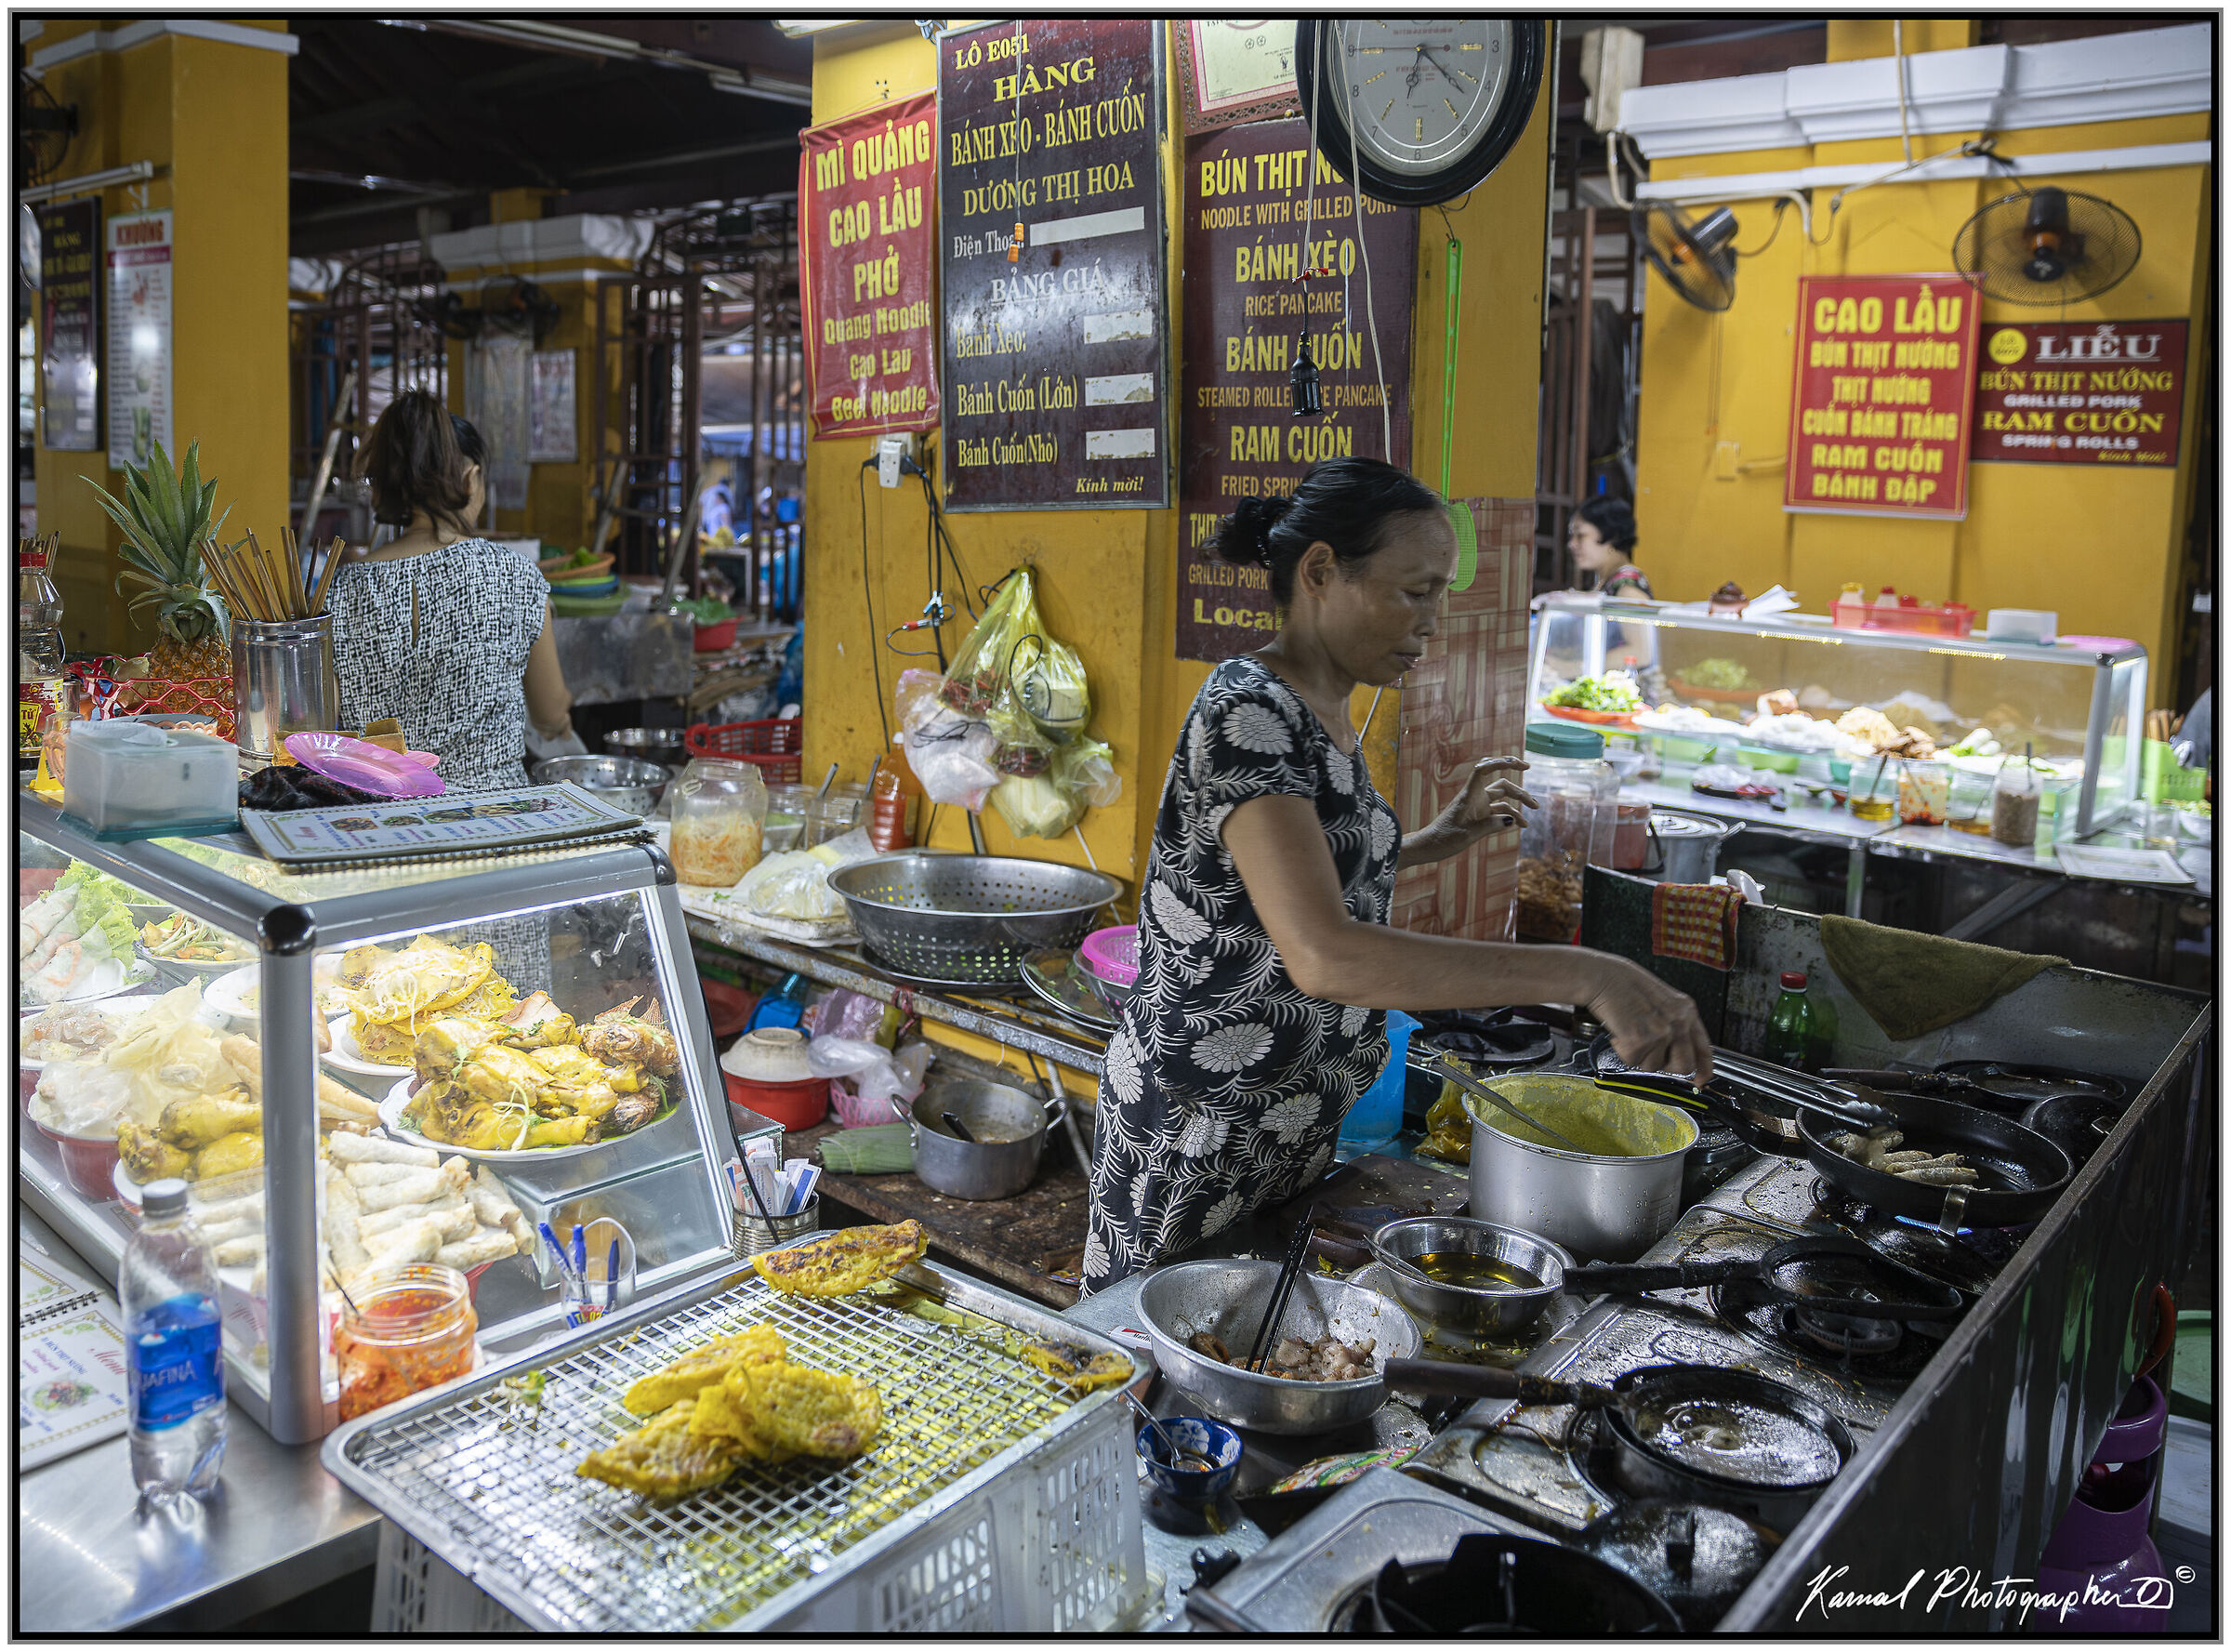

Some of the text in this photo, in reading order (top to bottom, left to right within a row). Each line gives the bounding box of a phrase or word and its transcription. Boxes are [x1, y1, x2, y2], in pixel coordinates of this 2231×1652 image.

[956, 33, 1029, 70] LÔ E051
[993, 56, 1096, 102] HÀNG
[951, 123, 996, 166] BÁNH
[998, 110, 1032, 157] XÈO
[1045, 98, 1091, 149] BÁNH
[1097, 76, 1146, 136] CUỐN
[815, 119, 931, 192] MÌ QUẢNG
[1200, 149, 1247, 197] BÚN
[1254, 150, 1307, 198] THỊT
[963, 160, 1135, 218] DƯƠNG THỊ HOA
[829, 205, 870, 248] CAO
[1201, 204, 1251, 231] NOODLE
[1256, 201, 1289, 226] WITH
[1294, 195, 1353, 222] GRILLED
[953, 233, 983, 260] Điện
[1235, 231, 1356, 283] BÁNH XÈO
[853, 243, 900, 303] PHỞ
[991, 257, 1106, 304] BẢNG GIÁ
[1246, 290, 1343, 316] RICE PANCAKE
[1814, 297, 1883, 334] CAO
[824, 313, 871, 345] Quang
[850, 348, 912, 380] Cao Lau
[1226, 326, 1288, 373] BÁNH
[1810, 336, 1961, 374] BÚN THỊT NƯỚNG
[957, 372, 1078, 416] Bánh Cuốn (Lớn)
[1197, 386, 1250, 408] STEAMED
[1254, 386, 1294, 408] ROLLE
[1335, 383, 1393, 407] PANCAKE
[1831, 373, 1933, 407] THỊT NƯỚNG
[1979, 366, 2174, 394] BÚN THỊT NƯỚNG
[831, 385, 927, 422] Beef Noodle
[1980, 406, 2166, 434] RAM CUỐN
[2003, 394, 2143, 409] GRILLED PORK
[1230, 410, 1353, 463] RAM CUỐN
[1851, 404, 1898, 439] BÁNH
[1901, 406, 1959, 442] TRÁNG
[957, 438, 990, 468] Bánh
[1812, 440, 1944, 474] RAM CUỐN
[2076, 436, 2140, 451] ROLLS
[1221, 475, 1260, 496] FRIED
[1812, 469, 1879, 500] BÁNH
[1188, 563, 1269, 591] GRILLED PORK
